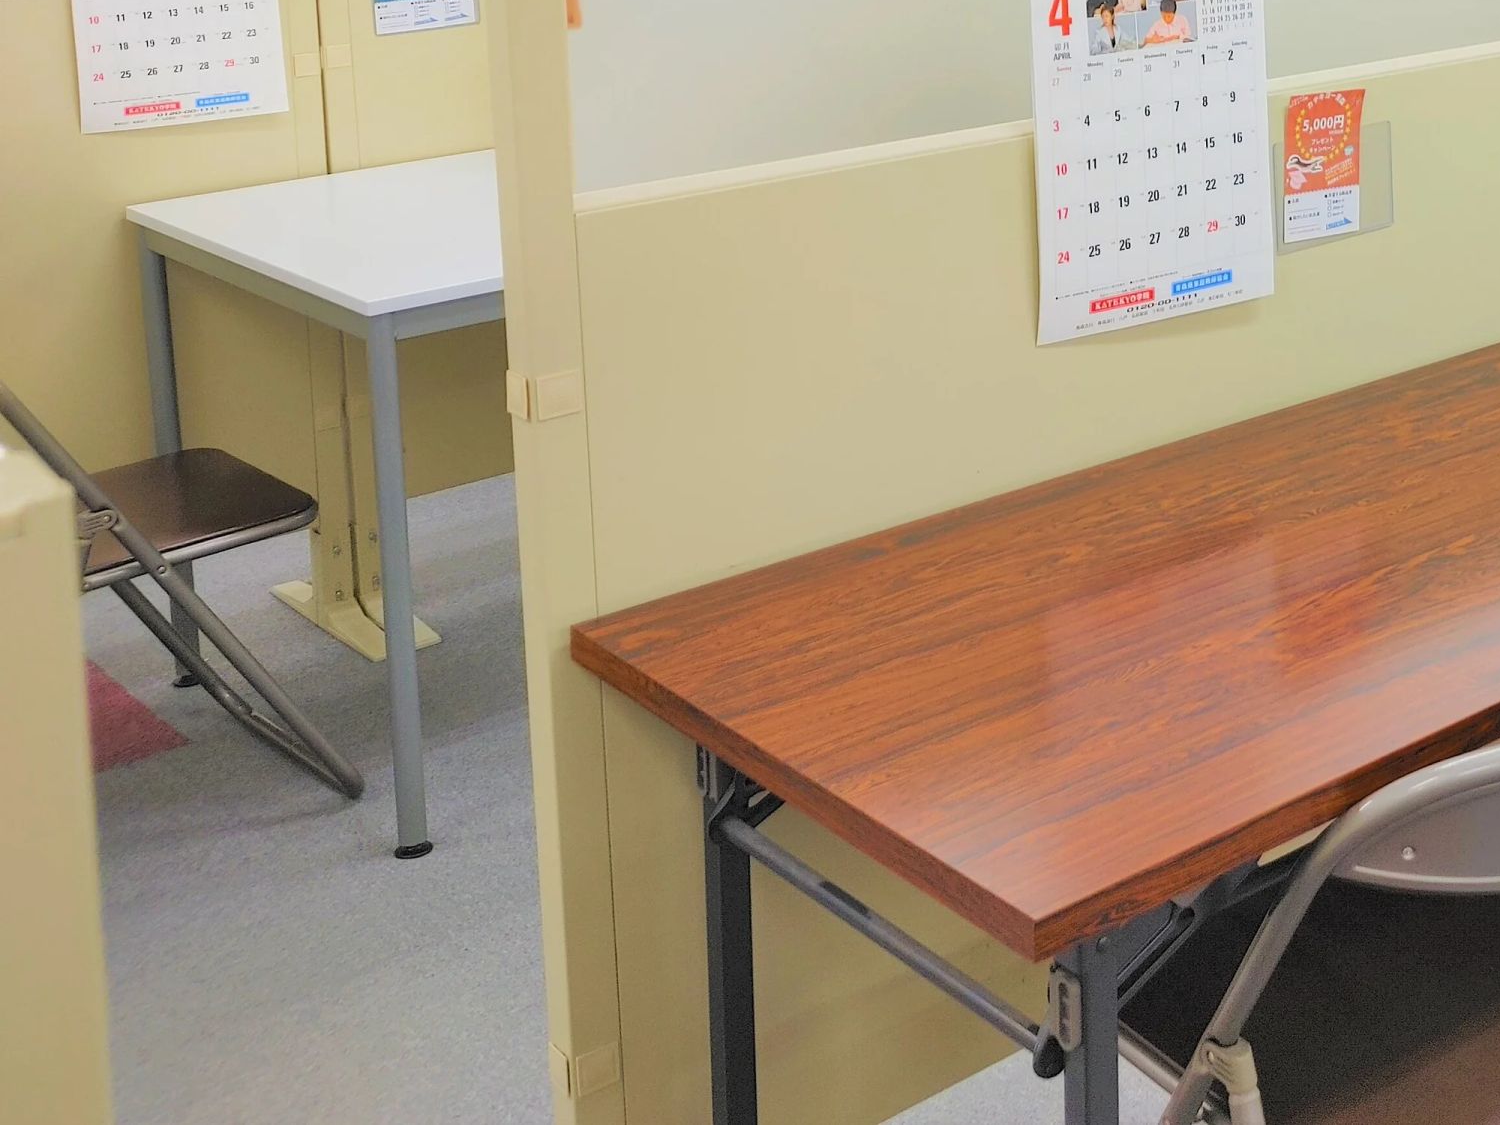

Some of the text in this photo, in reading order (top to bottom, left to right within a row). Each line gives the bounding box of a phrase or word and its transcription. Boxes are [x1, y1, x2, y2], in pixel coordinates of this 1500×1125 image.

[194, 6, 203, 14] 14
[92, 45, 101, 53] 17
[119, 42, 128, 50] 18
[171, 37, 180, 45] 20
[247, 29, 256, 37] 23
[94, 73, 104, 81] 24
[121, 70, 131, 78] 25
[200, 62, 209, 70] 28
[225, 59, 234, 67] 29
[250, 56, 259, 64] 30
[1053, 51, 1072, 62] APRIL
[1083, 74, 1091, 82] 28
[1114, 69, 1121, 77] 29
[1144, 64, 1151, 72] 30
[1172, 59, 1180, 69] 31
[1202, 54, 1205, 64] 1
[1228, 50, 1233, 60] 2
[1117, 56, 1134, 64] Tuesday
[1054, 92, 1235, 132] 3 4 5 6 7 8 9
[1302, 114, 1345, 135] 5,000円
[1057, 132, 1242, 175] 10 11 12 13 14 15 16
[1311, 137, 1334, 146] プレゼント
[1058, 174, 1244, 219] 17 18 19 20 21 22 23
[1058, 215, 1245, 264] 24 25 26 27 28 29 30
[1094, 290, 1151, 311] KATEKYO学院
